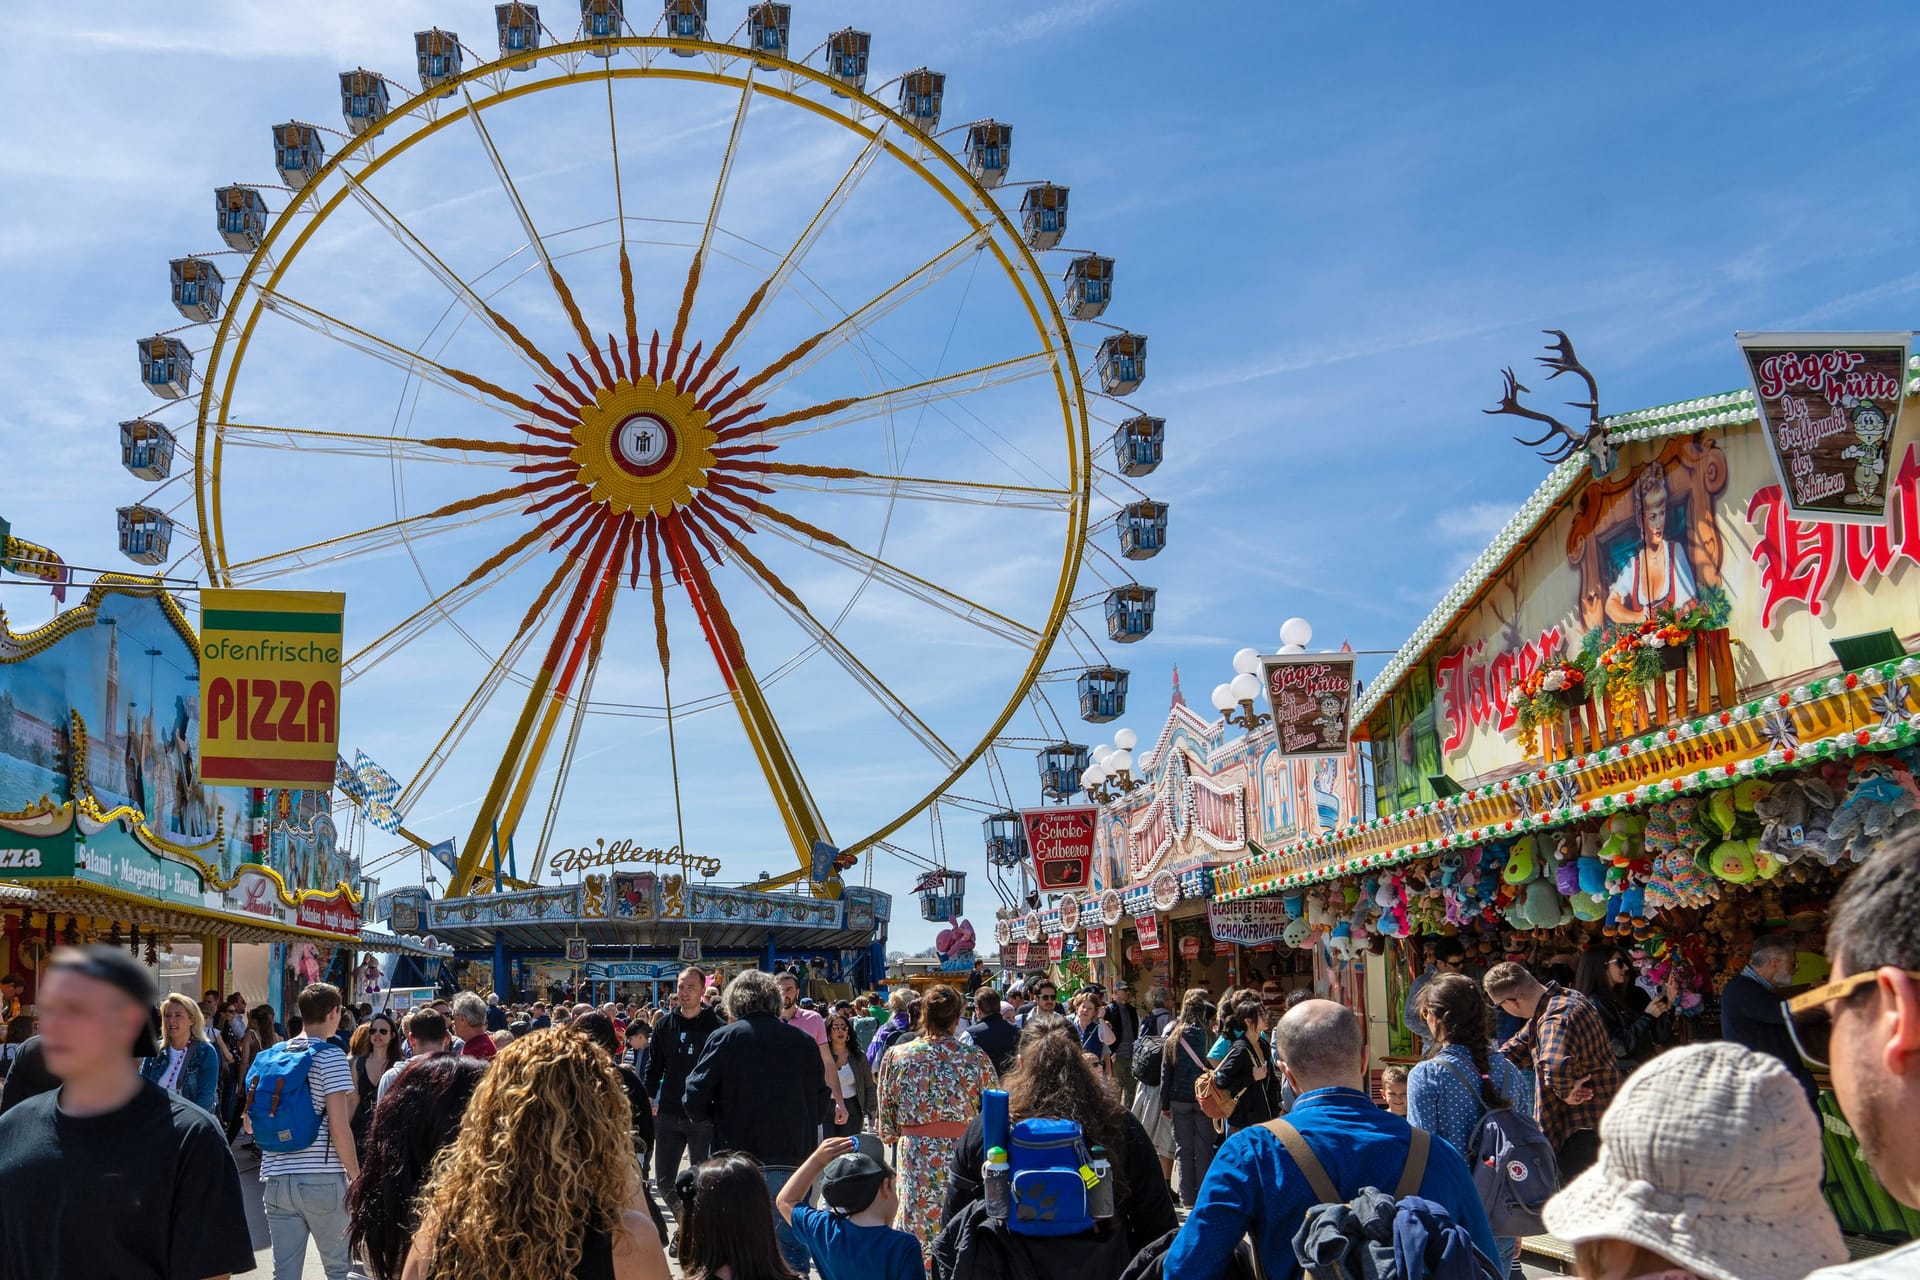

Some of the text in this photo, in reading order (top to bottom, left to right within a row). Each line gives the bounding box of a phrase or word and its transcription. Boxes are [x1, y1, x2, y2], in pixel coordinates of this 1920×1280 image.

[1760, 350, 1864, 399] Jäger-
[1825, 372, 1899, 404] hütte
[1781, 394, 1808, 421] Der
[1779, 406, 1846, 450] Treffpunkt
[1792, 450, 1813, 477] der
[1796, 473, 1845, 505] Schützen
[204, 638, 339, 663] ofenfrische
[1271, 663, 1331, 695] Jäger-
[1305, 675, 1350, 696] hütte
[207, 677, 335, 743] PIZZA
[1040, 822, 1087, 840] Schoko-
[550, 838, 721, 877] Willenborg
[1037, 840, 1089, 860] Erdbeeren
[80, 844, 112, 876] Salami
[121, 857, 166, 891] Margaritha
[1212, 900, 1285, 915] GLASIERTE FRÜCHTE
[1242, 914, 1252, 922] &
[1217, 923, 1284, 939] SCHOKOFRÜCHTE
[613, 965, 653, 975] KASSE
